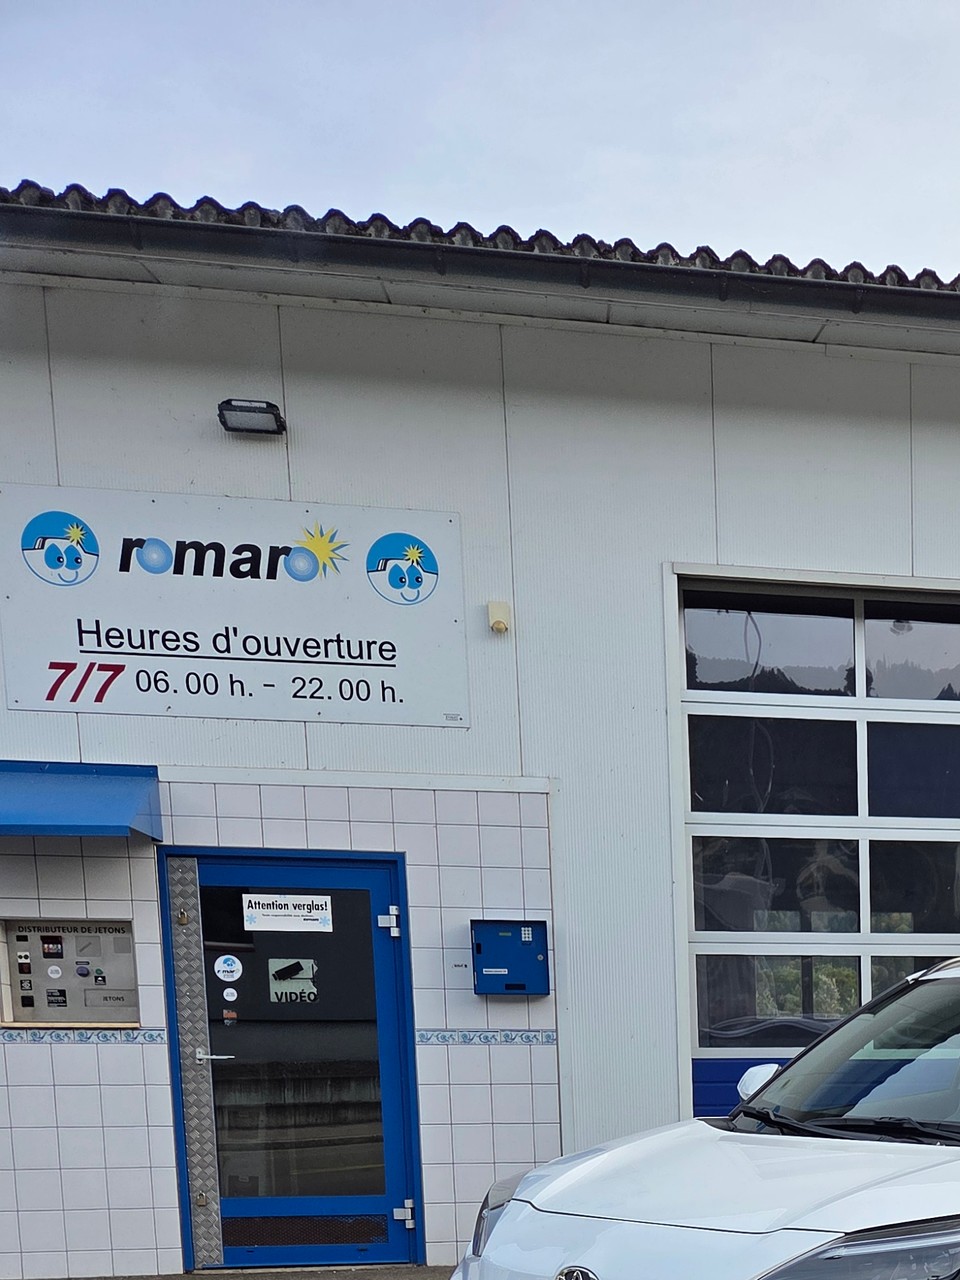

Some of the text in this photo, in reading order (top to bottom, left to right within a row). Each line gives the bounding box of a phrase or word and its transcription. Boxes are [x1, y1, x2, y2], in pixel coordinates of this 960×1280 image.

[118, 537, 319, 582] romaro
[77, 618, 397, 661] Heures d'ouverture
[45, 661, 126, 703] 7/7
[135, 669, 219, 696] 06.00
[229, 673, 253, 697] h.
[291, 676, 371, 701] 22.00
[381, 680, 404, 703] h.
[247, 899, 328, 913] Attention verglas!
[18, 925, 126, 935] DISTRIBUTEUR DE JETONS
[275, 989, 318, 1003] VIDÉO
